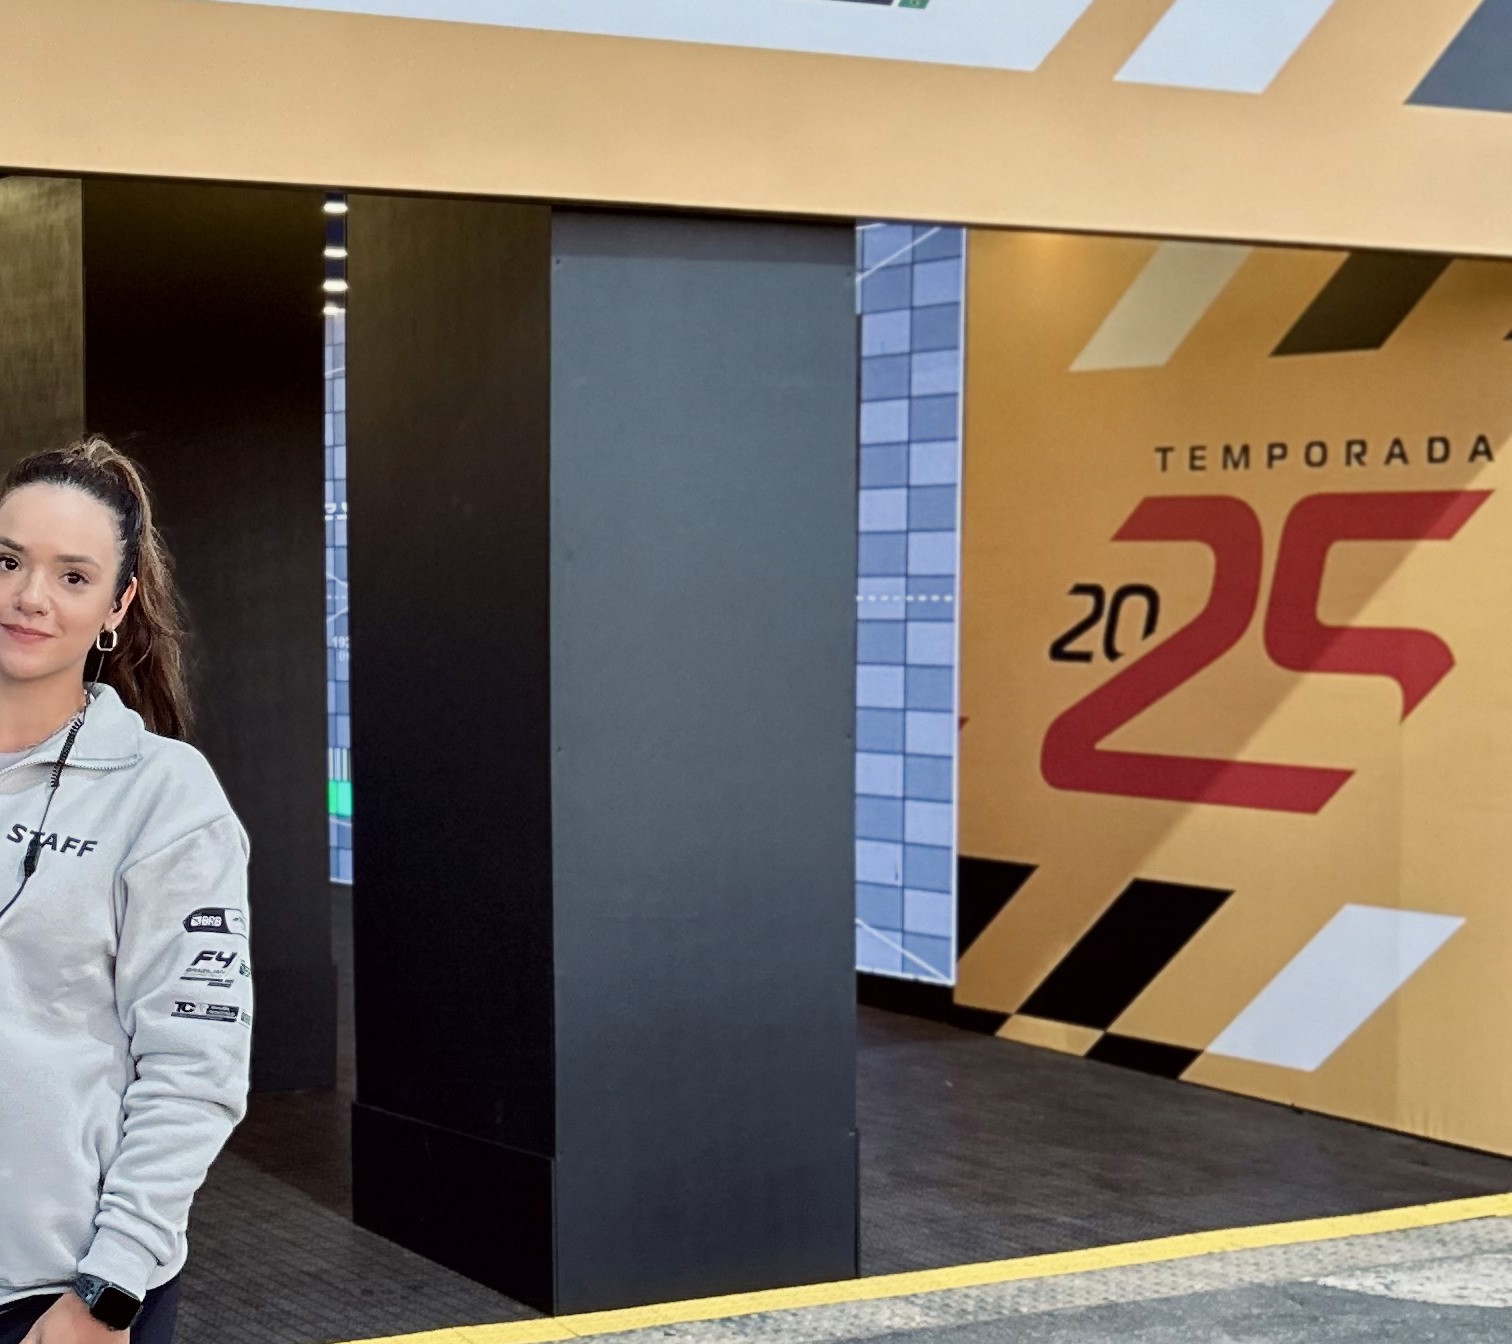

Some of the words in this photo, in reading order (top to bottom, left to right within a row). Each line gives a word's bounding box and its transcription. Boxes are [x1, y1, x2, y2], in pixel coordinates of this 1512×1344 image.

[1154, 434, 1496, 473] TEMPORADA
[1048, 583, 1160, 664] 20
[201, 915, 223, 927] BRB
[190, 949, 238, 969] F4
